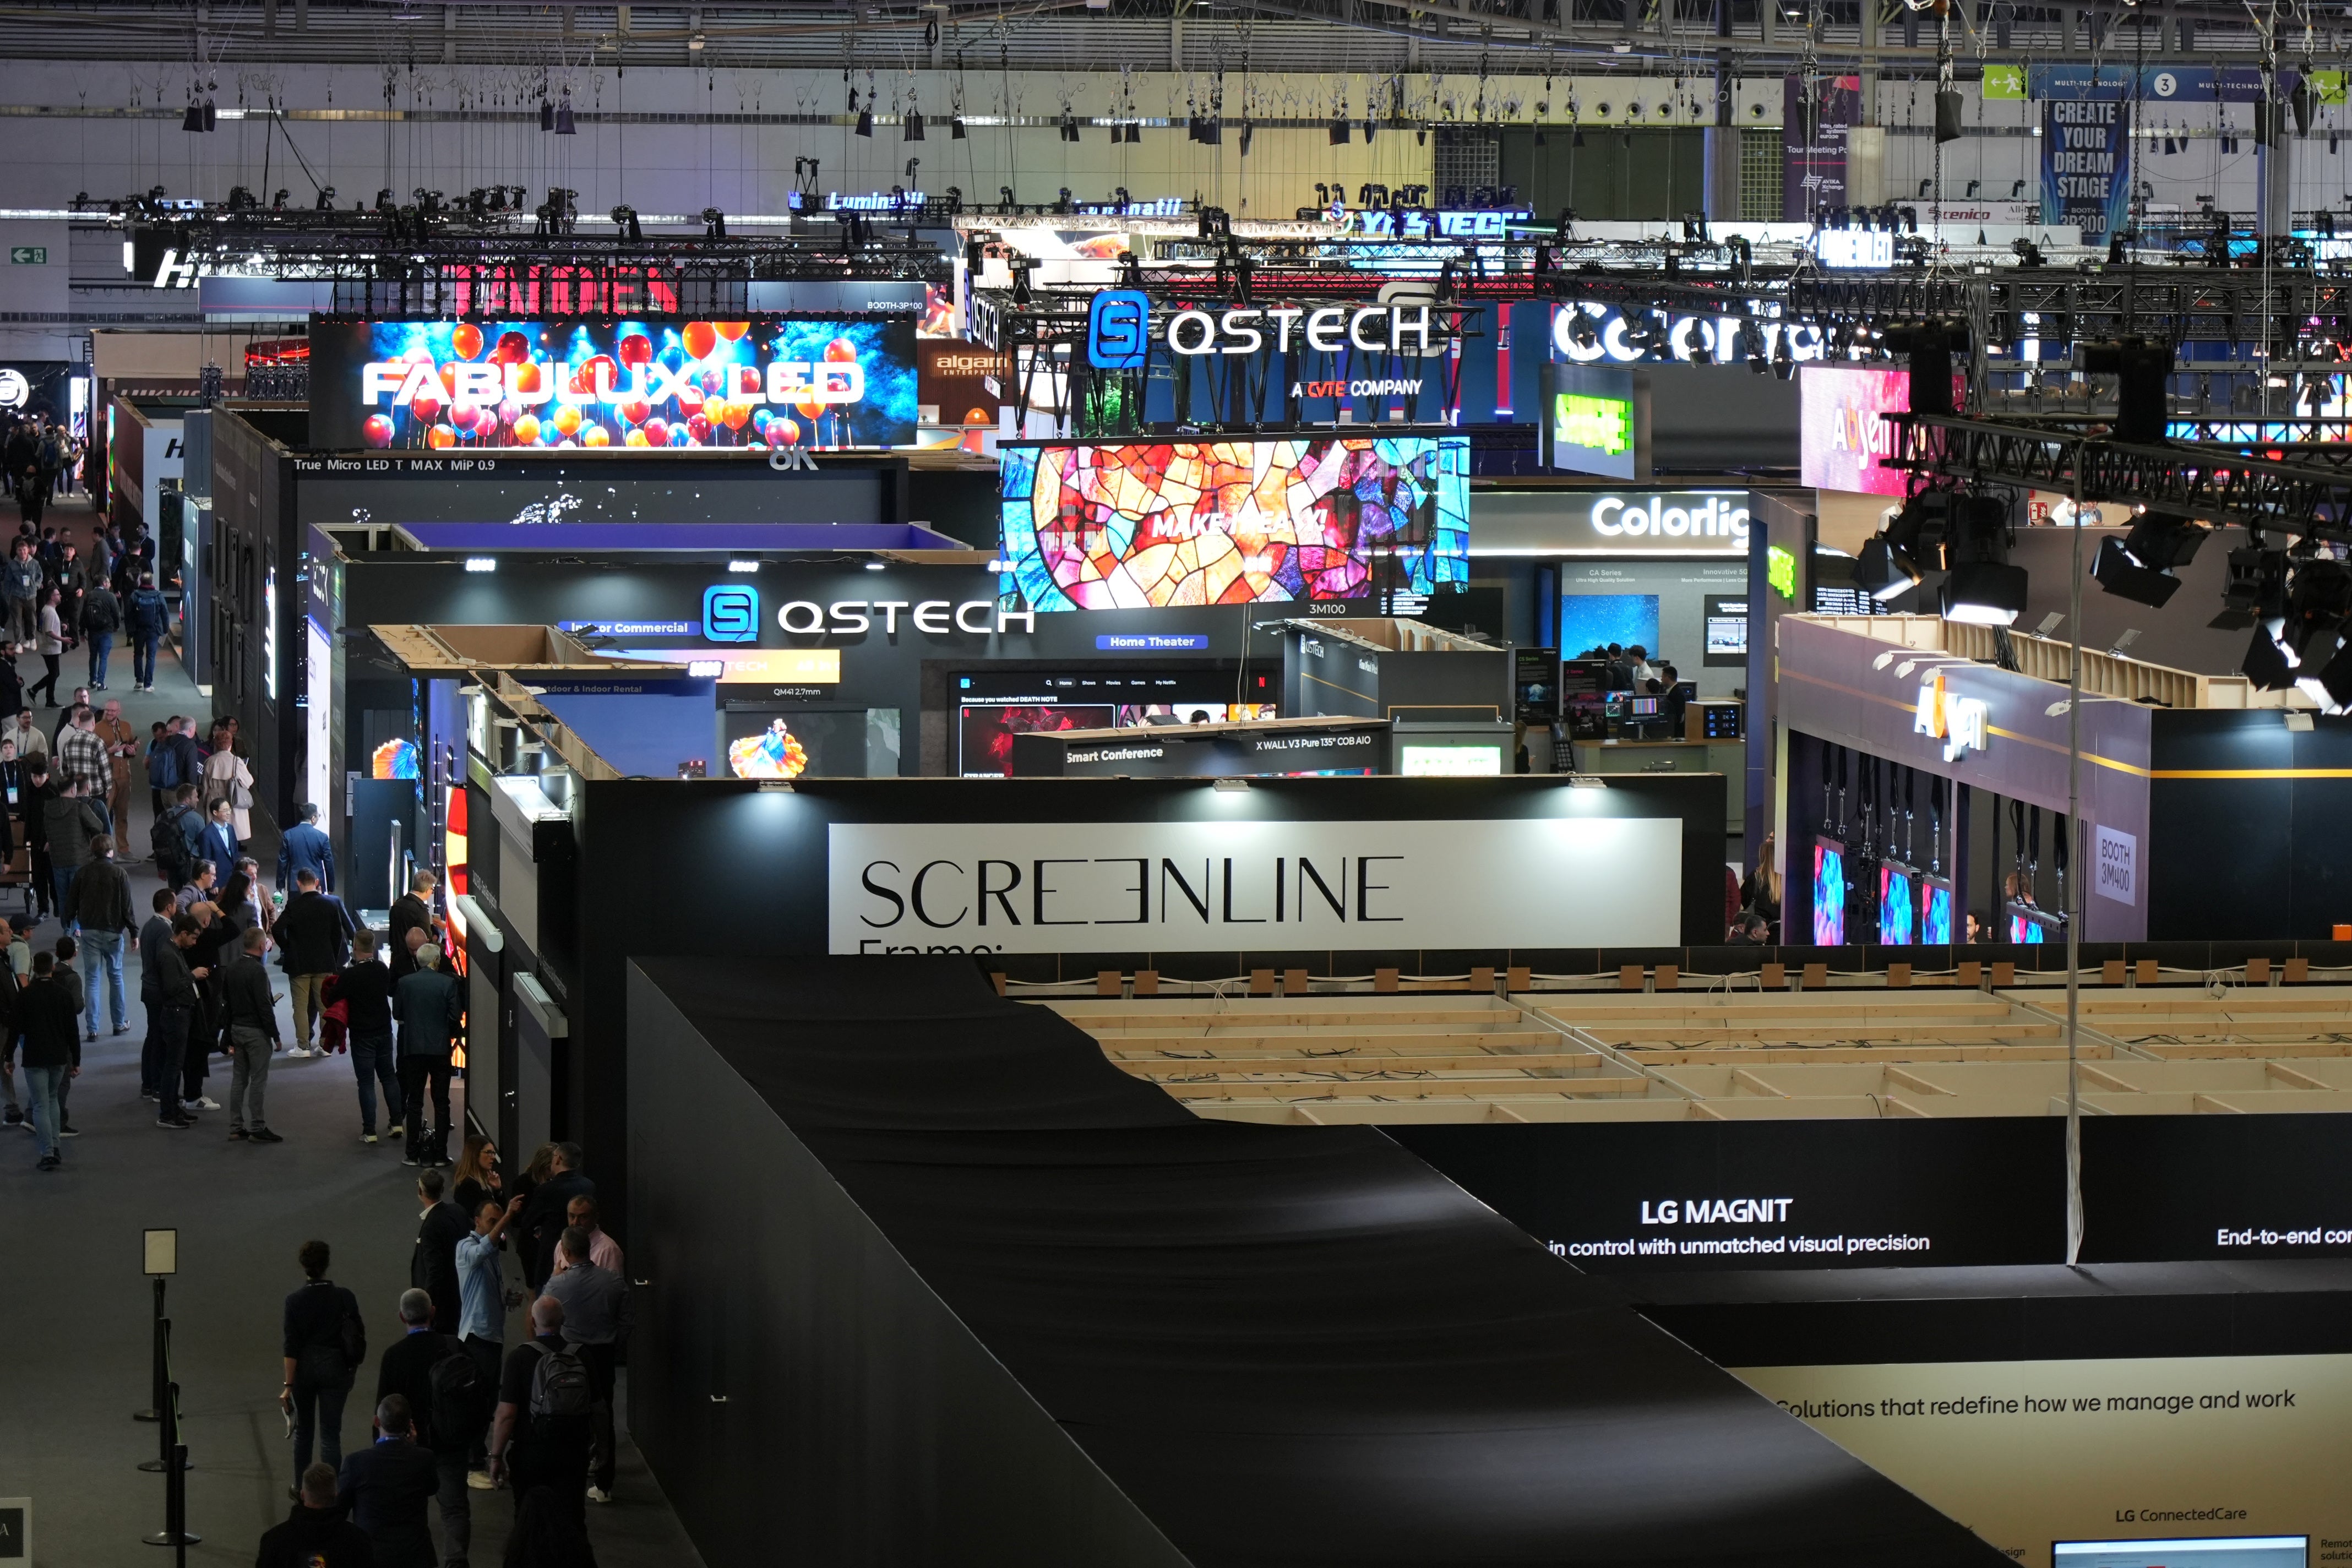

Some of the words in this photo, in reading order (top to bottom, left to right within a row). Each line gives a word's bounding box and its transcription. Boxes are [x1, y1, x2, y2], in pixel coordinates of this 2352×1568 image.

[2160, 79, 2169, 92] 3
[2054, 102, 2115, 124] CREATE
[2063, 127, 2106, 149] YOUR
[2054, 152, 2114, 174] DREAM
[2057, 177, 2109, 198] STAGE
[867, 301, 923, 311] BOOTH-3P100
[1167, 306, 1429, 355] QSTECH
[727, 361, 865, 404] LED
[1292, 382, 1303, 398] A
[1308, 382, 1346, 398] CVTE
[1351, 379, 1423, 396] COMPANY
[1832, 395, 1890, 471] Absen
[295, 459, 321, 470] True
[328, 459, 361, 470] Micro
[366, 460, 389, 470] LED
[411, 460, 443, 470] MAX
[451, 459, 474, 470] MiP
[478, 459, 496, 471] 0.9
[1152, 512, 1227, 537] MAKE
[777, 601, 1035, 634] QSTECH
[1309, 604, 1346, 615] 3M100
[614, 623, 688, 633] Commercial
[1110, 636, 1145, 647] Home
[1148, 636, 1195, 647] Theater
[542, 685, 571, 693] utdoor
[582, 685, 611, 693] Indoor
[795, 688, 821, 696] 2.7mm
[1264, 741, 1287, 750] WALL
[1288, 740, 1300, 749] V3
[1302, 739, 1319, 748] Pure
[1337, 737, 1355, 746] COB
[1355, 736, 1371, 745] AIO
[1067, 751, 1099, 763] Smart
[1101, 748, 1163, 761] Conference
[2101, 838, 2130, 867] BOOTH
[2101, 861, 2130, 892] 3M400
[1642, 1200, 1679, 1225] LG
[1685, 1198, 1794, 1224] MAGNIT
[1569, 1238, 1635, 1256] control
[1638, 1238, 1676, 1255] with
[1680, 1237, 1785, 1254] unmatched
[1789, 1235, 1844, 1253] visual
[1847, 1233, 1930, 1255] precision
[2217, 1227, 2321, 1246] End-to-end
[1880, 1396, 1925, 1417] that
[1930, 1394, 2019, 1417] redefine
[2024, 1393, 2067, 1414] how
[2072, 1398, 2101, 1413] we
[2107, 1396, 2194, 1415] manage
[2199, 1391, 2241, 1411] and
[2245, 1389, 2296, 1409] work
[2115, 1510, 2135, 1523] LG
[2140, 1507, 2247, 1522] ConnectedCare
